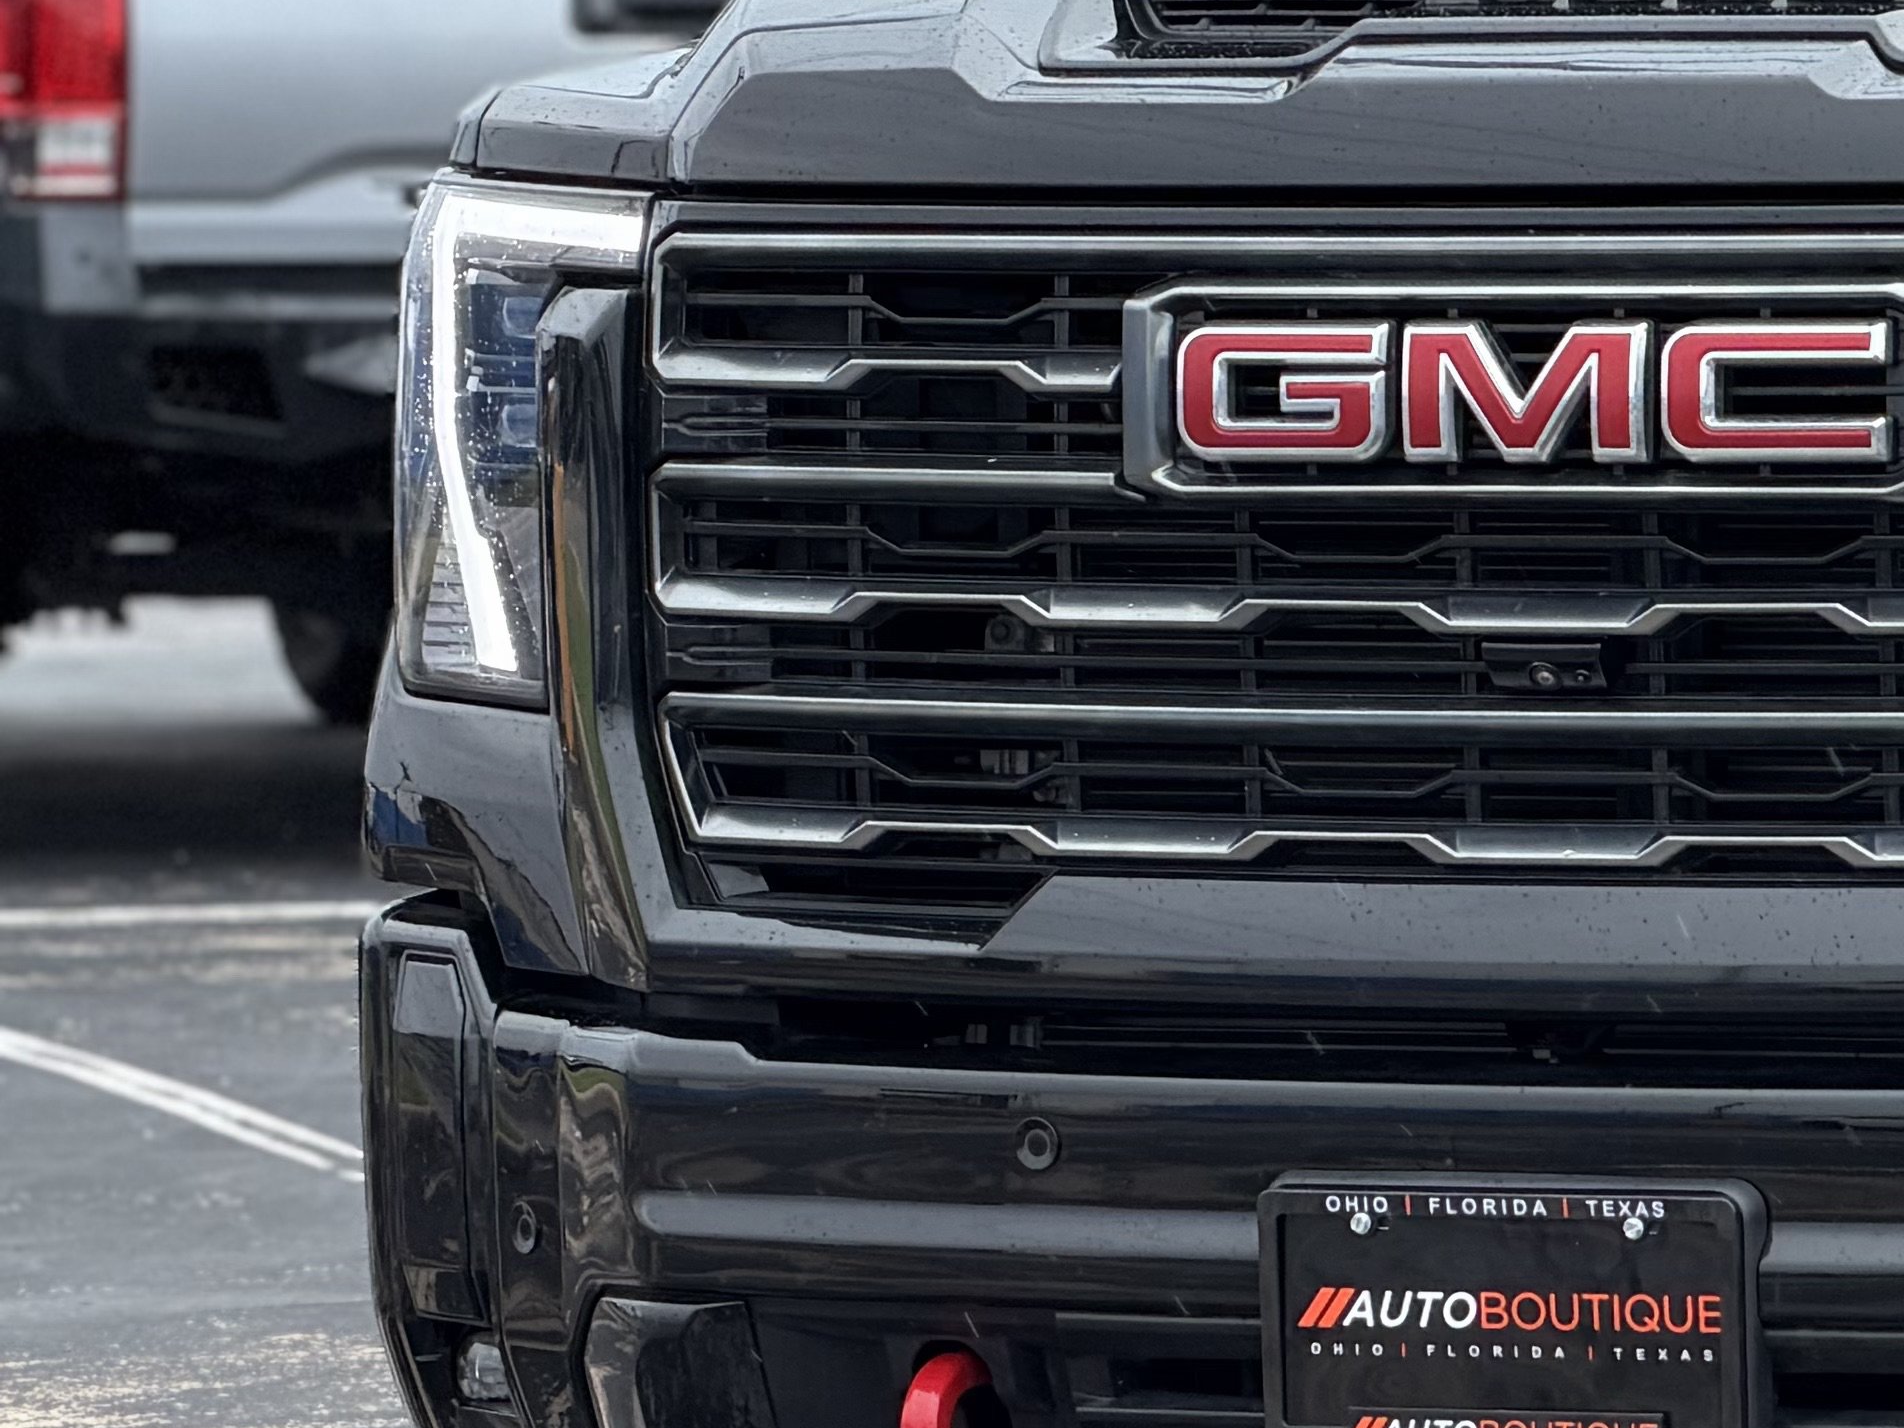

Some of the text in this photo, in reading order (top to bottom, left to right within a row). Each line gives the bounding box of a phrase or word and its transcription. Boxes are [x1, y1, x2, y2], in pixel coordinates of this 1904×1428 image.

[1176, 322, 1887, 463] GMC
[1325, 1195, 1665, 1218] OHIO FLORIDA TEXAS
[1343, 1290, 1722, 1333] AUTOBOUTIQUE
[1311, 1342, 1714, 1362] OHIO FLORIDA TEXAS
